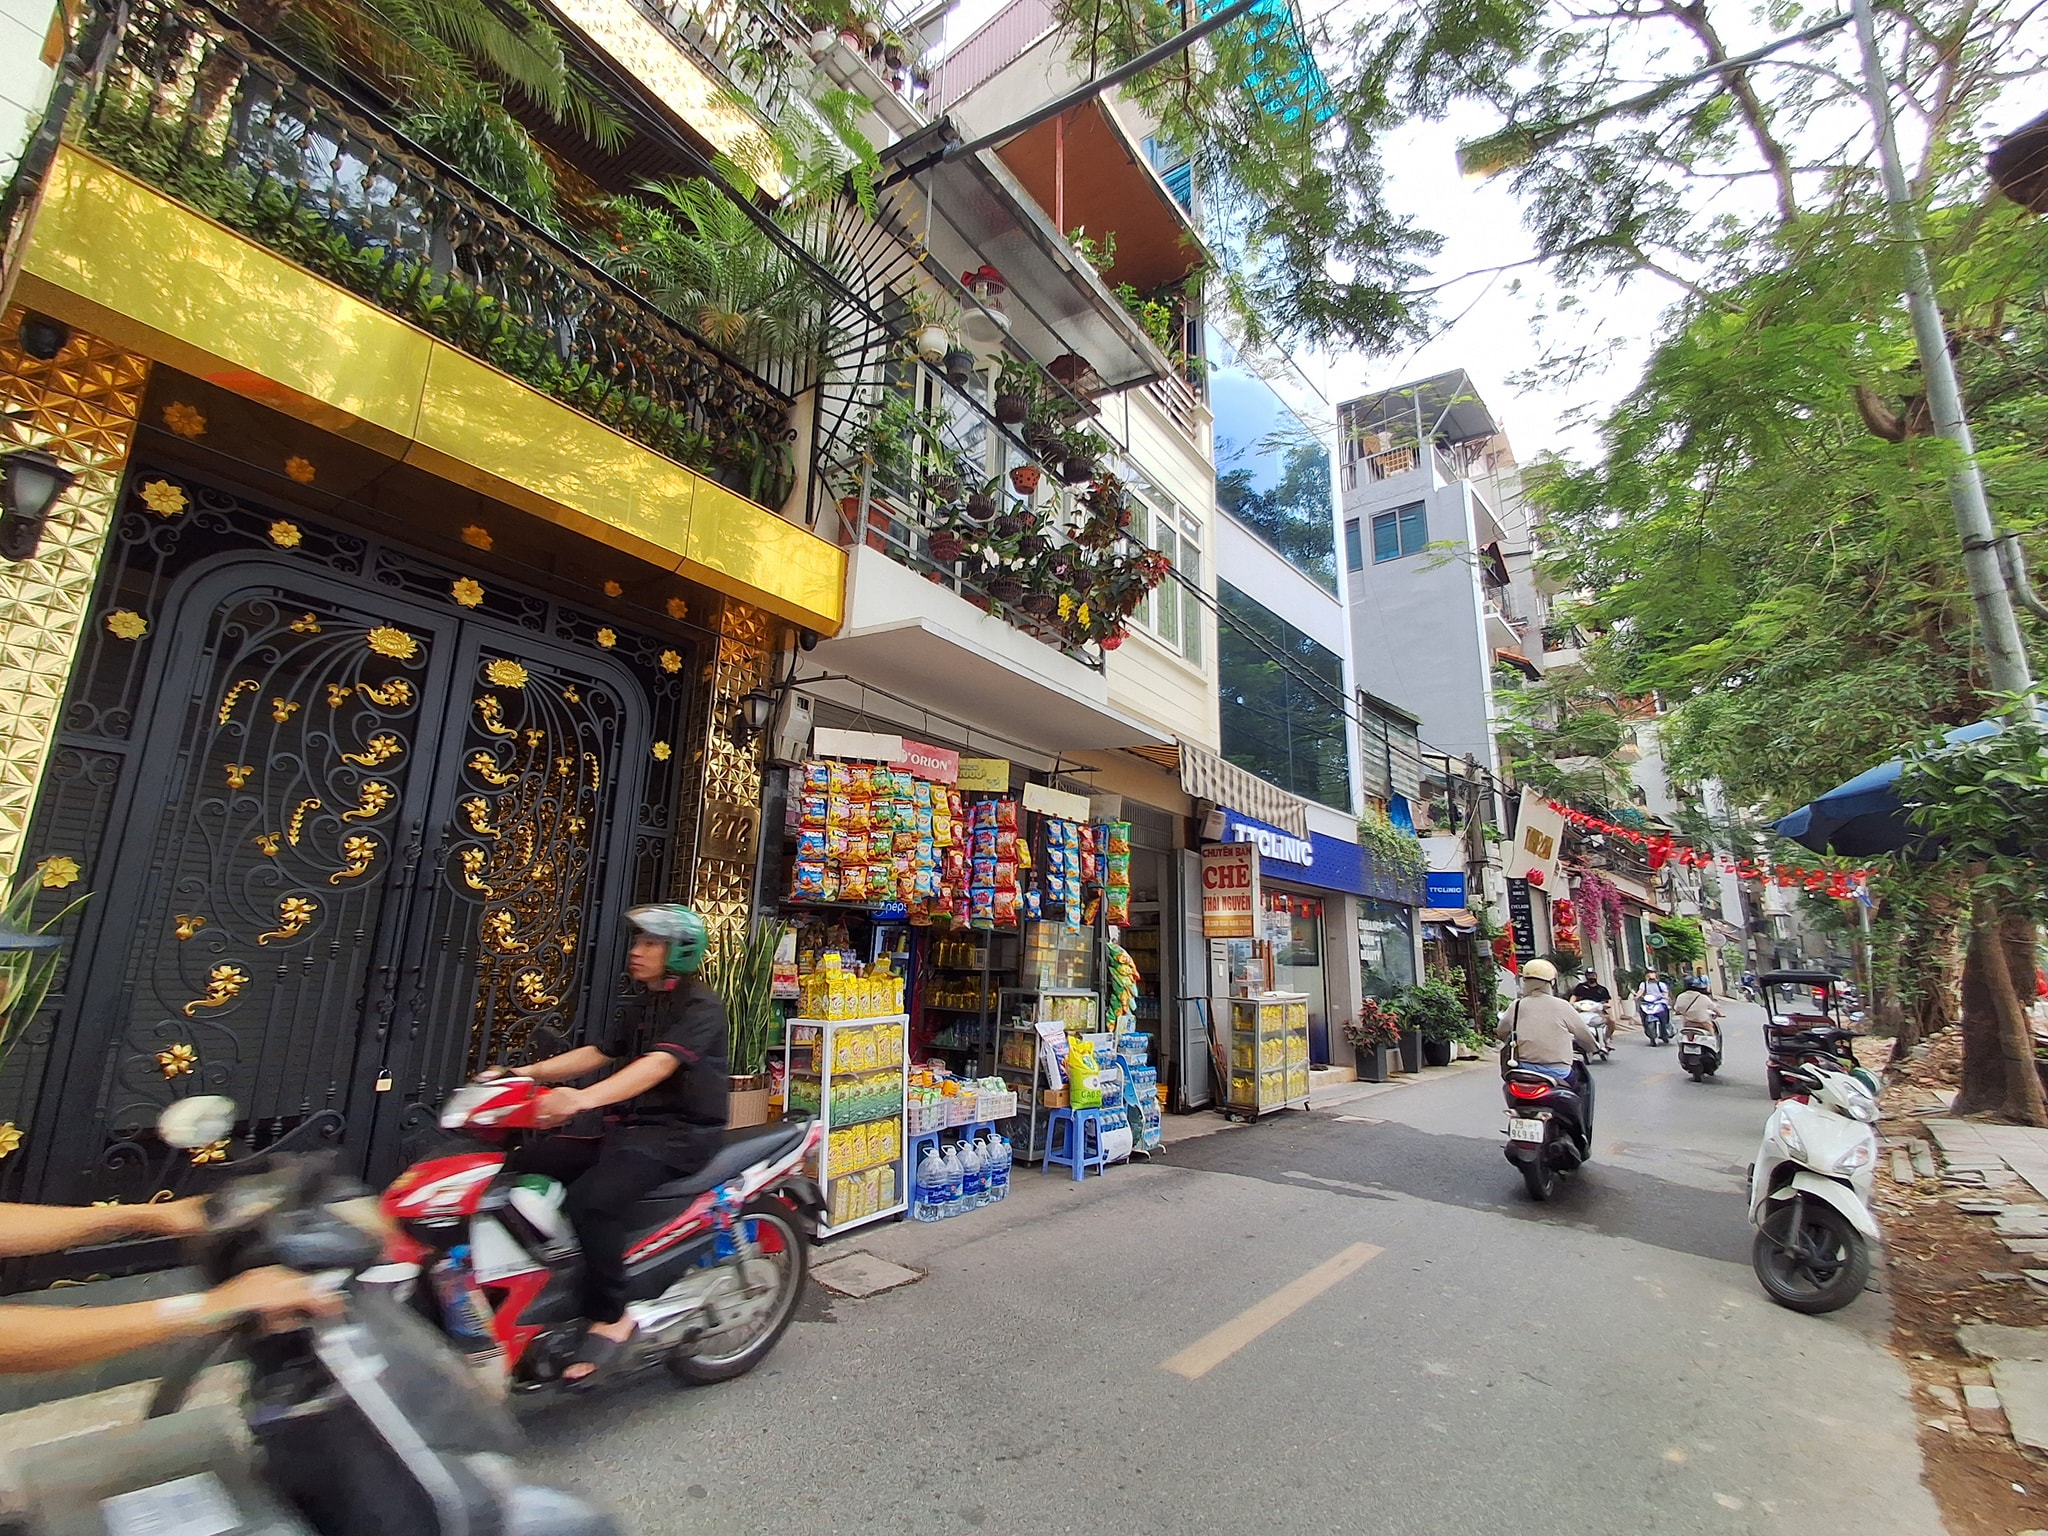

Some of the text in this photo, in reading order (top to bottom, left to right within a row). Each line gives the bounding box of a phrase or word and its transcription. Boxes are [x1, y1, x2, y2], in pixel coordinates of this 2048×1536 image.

[710, 811, 753, 844] 272
[1202, 858, 1250, 890] CHÈ
[885, 902, 907, 914] peps
[1203, 891, 1251, 912] THÁI NGUYÊN
